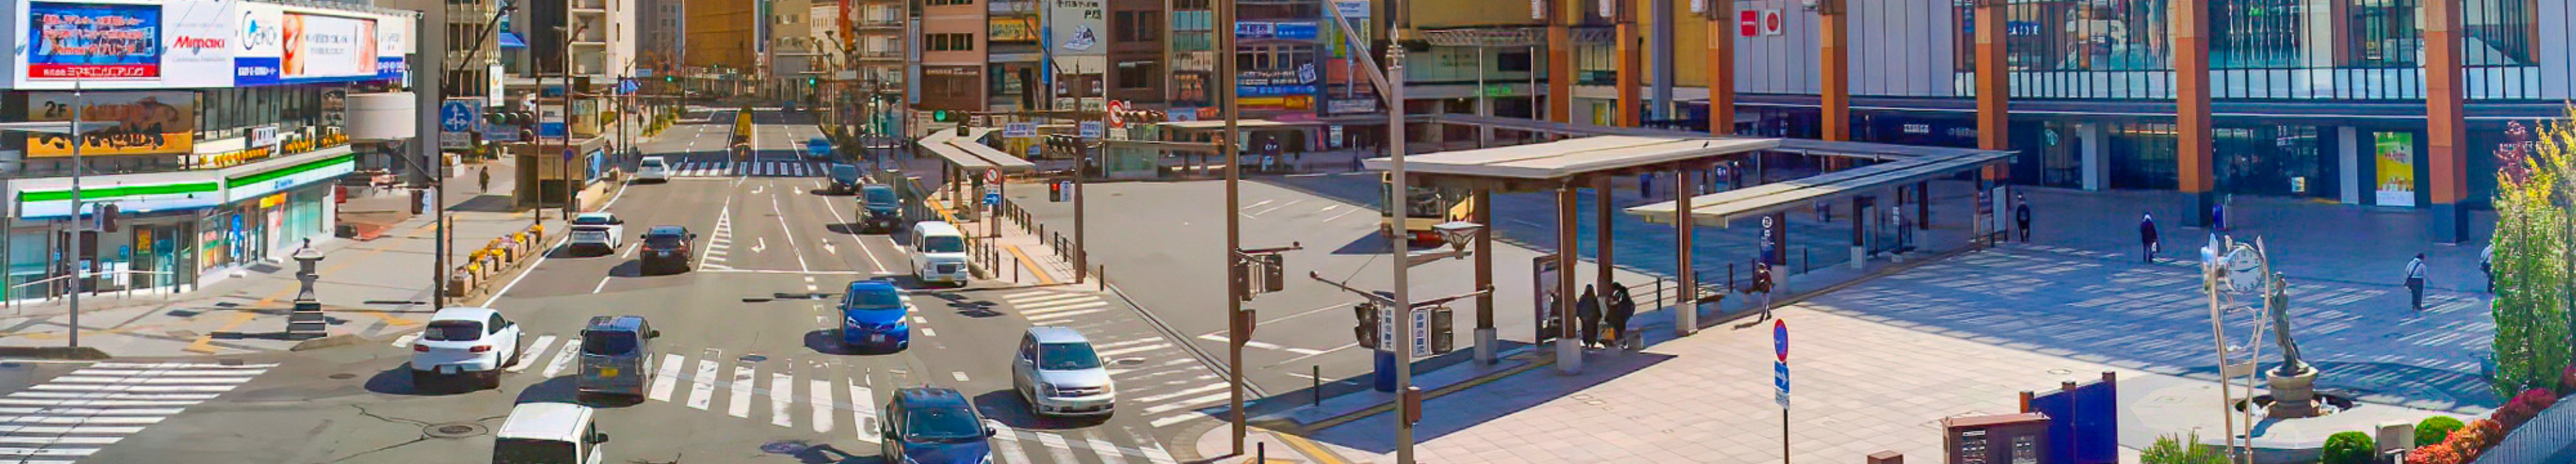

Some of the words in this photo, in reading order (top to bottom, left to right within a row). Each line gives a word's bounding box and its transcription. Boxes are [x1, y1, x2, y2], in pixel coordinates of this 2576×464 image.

[173, 36, 225, 48] Mimaki
[68, 67, 144, 76] ミマキエンジニアリング
